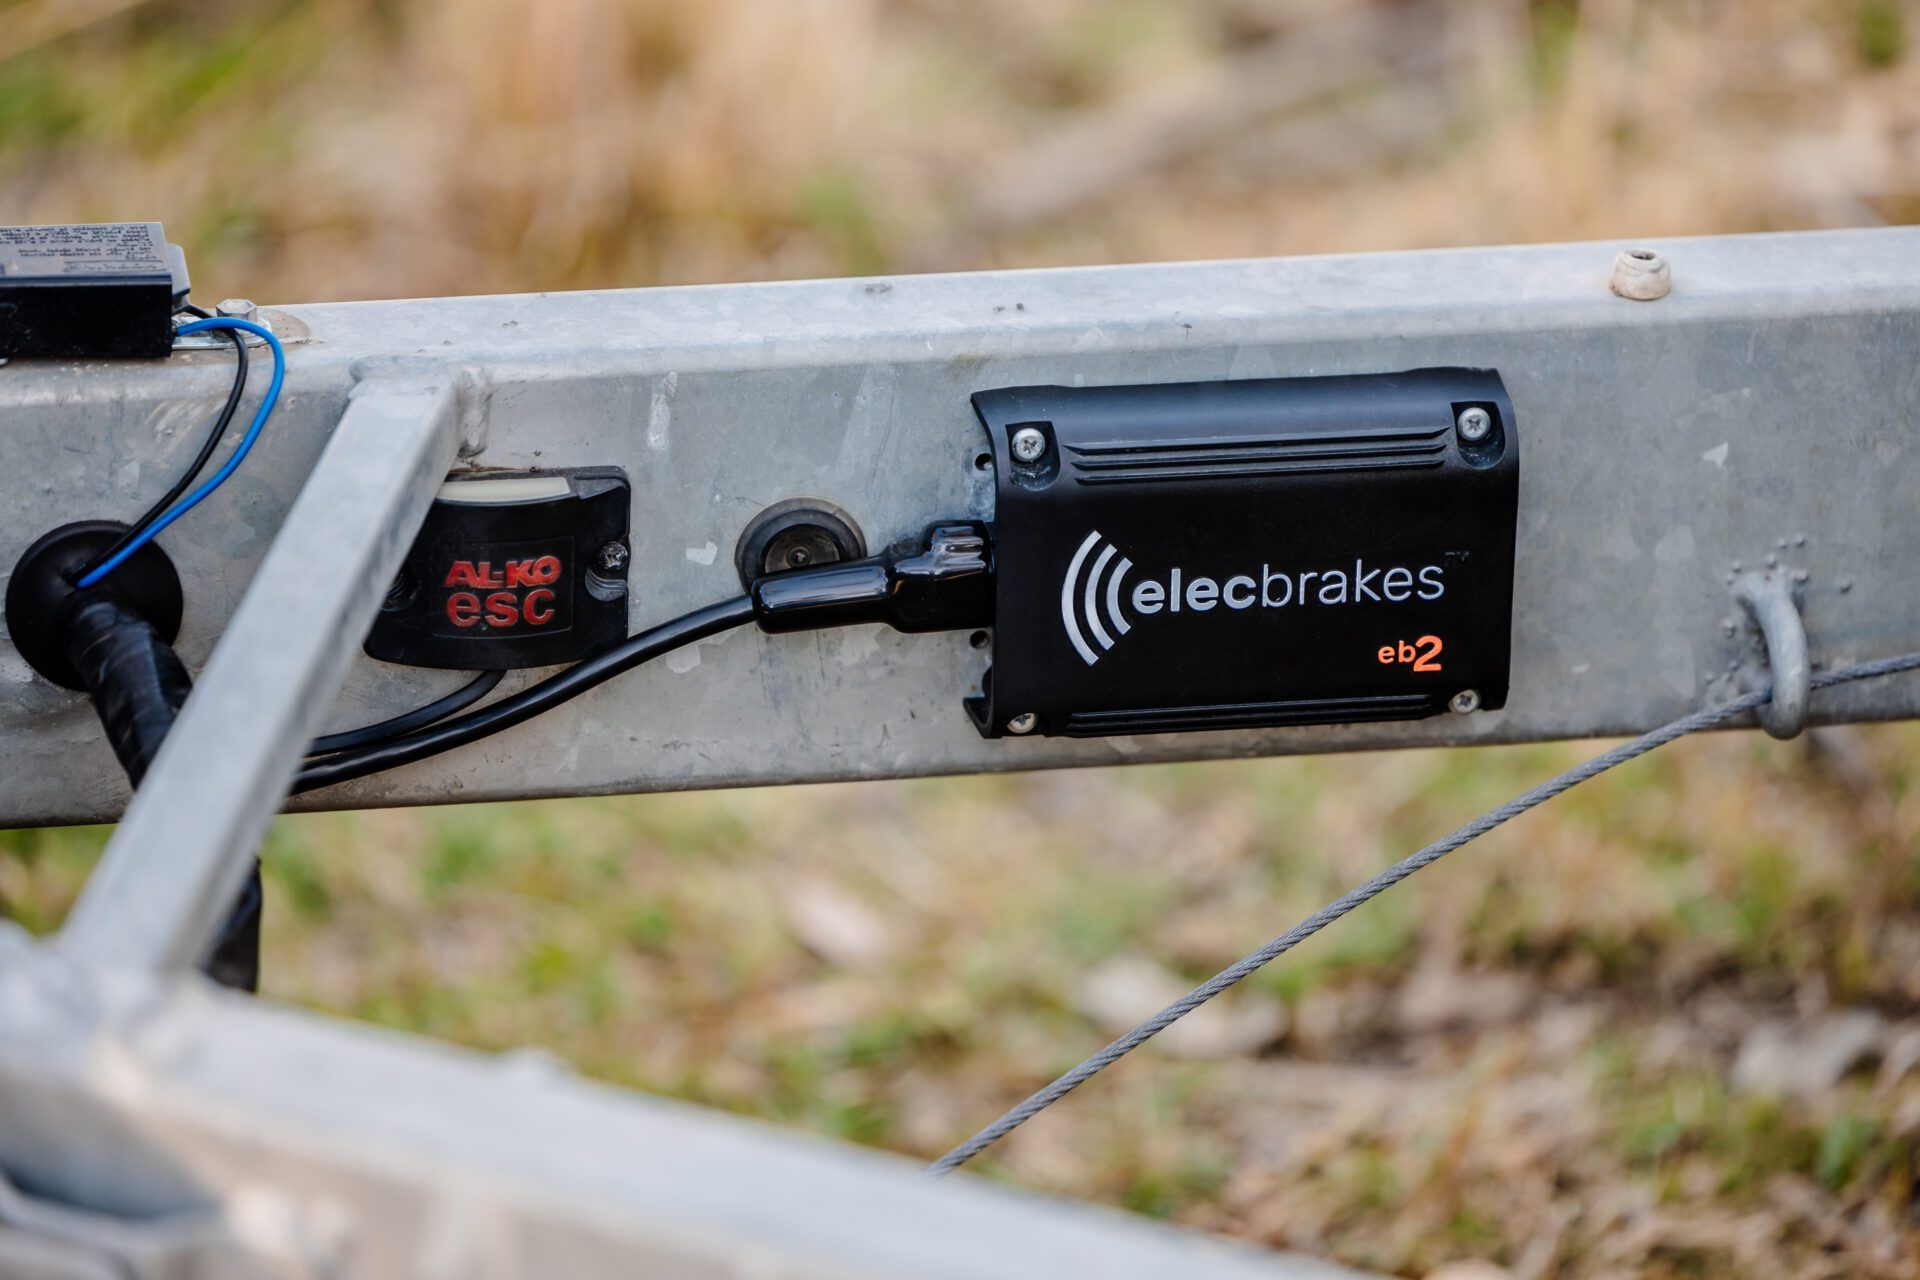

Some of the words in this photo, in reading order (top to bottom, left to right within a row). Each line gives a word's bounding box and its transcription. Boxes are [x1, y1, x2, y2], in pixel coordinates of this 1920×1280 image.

[1132, 558, 1445, 614] elecbrakes
[446, 588, 555, 627] esc
[1377, 635, 1443, 672] eb2
